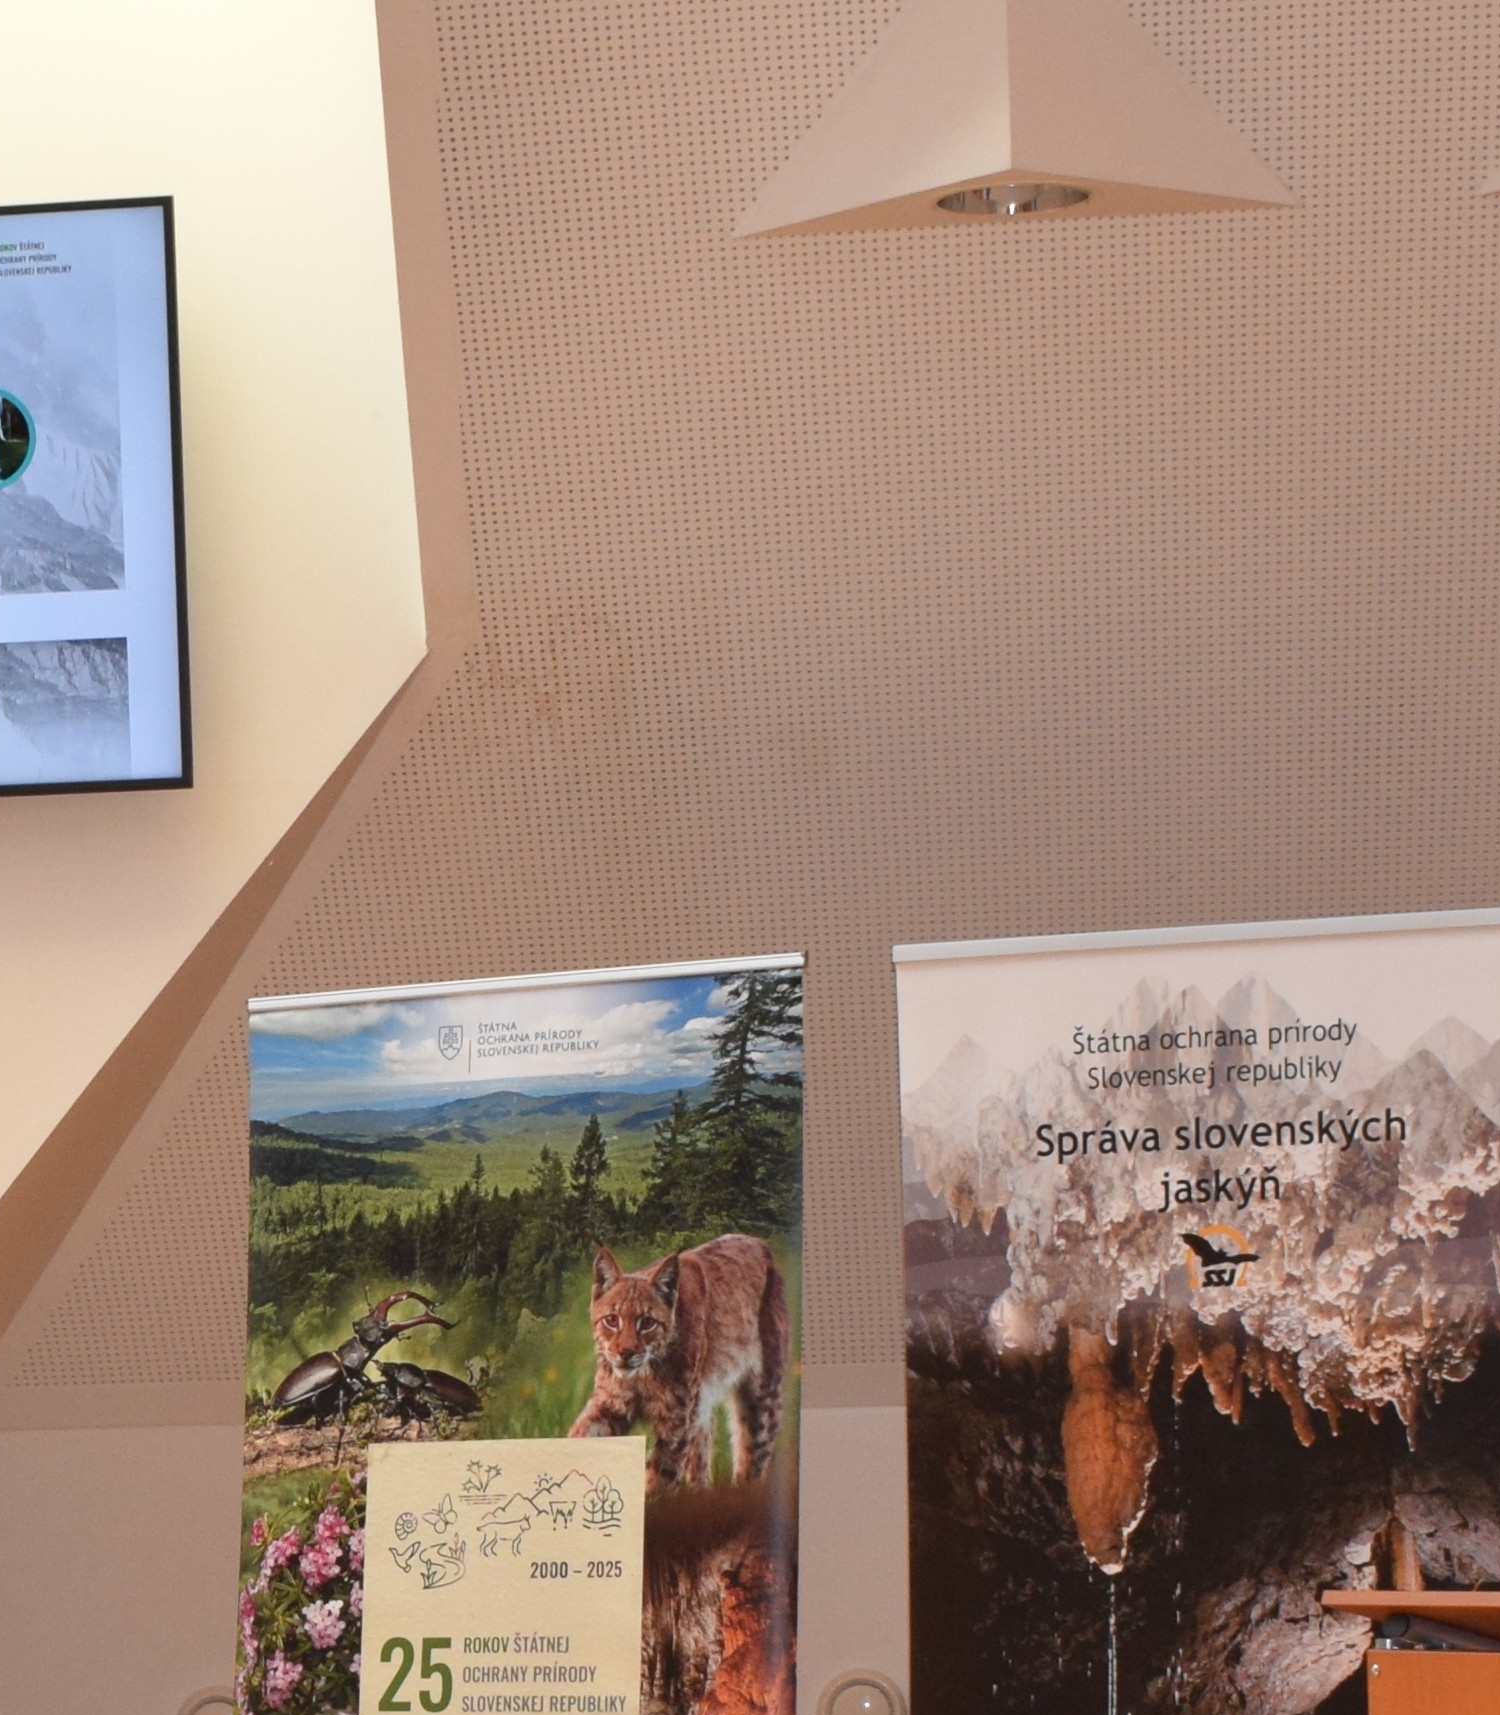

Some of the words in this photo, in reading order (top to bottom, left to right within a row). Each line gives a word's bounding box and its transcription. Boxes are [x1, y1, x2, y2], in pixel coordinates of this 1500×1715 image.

[477, 1034, 530, 1045] OCHRANA
[535, 1029, 583, 1041] PRÍRODY
[478, 1021, 517, 1034] ŠTÁTNA
[1073, 1026, 1150, 1055] Štátna
[1159, 1024, 1257, 1050] ochrana
[1268, 1018, 1357, 1049] prírody
[477, 1044, 538, 1058] SLOVENSKEJ
[542, 1040, 599, 1052] REPUBLIKY
[1088, 1062, 1216, 1089] Slovenskej
[1226, 1055, 1342, 1084] republiky
[1035, 1121, 1161, 1164] Správa
[1175, 1107, 1406, 1151] slovenských
[1158, 1165, 1281, 1213] jaskýň
[1202, 1267, 1236, 1287] SSJ
[530, 1561, 568, 1579] 2000
[587, 1560, 622, 1578] 2025
[463, 1636, 510, 1653] ROKOV
[513, 1632, 569, 1653] ŠTÁTNEJ
[378, 1636, 453, 1713] 25
[463, 1666, 528, 1683] OCHRANY
[533, 1661, 597, 1683] PRÍRODY
[462, 1696, 544, 1713] SLOVENSKEJ
[549, 1696, 627, 1713] REPUBLIKY
